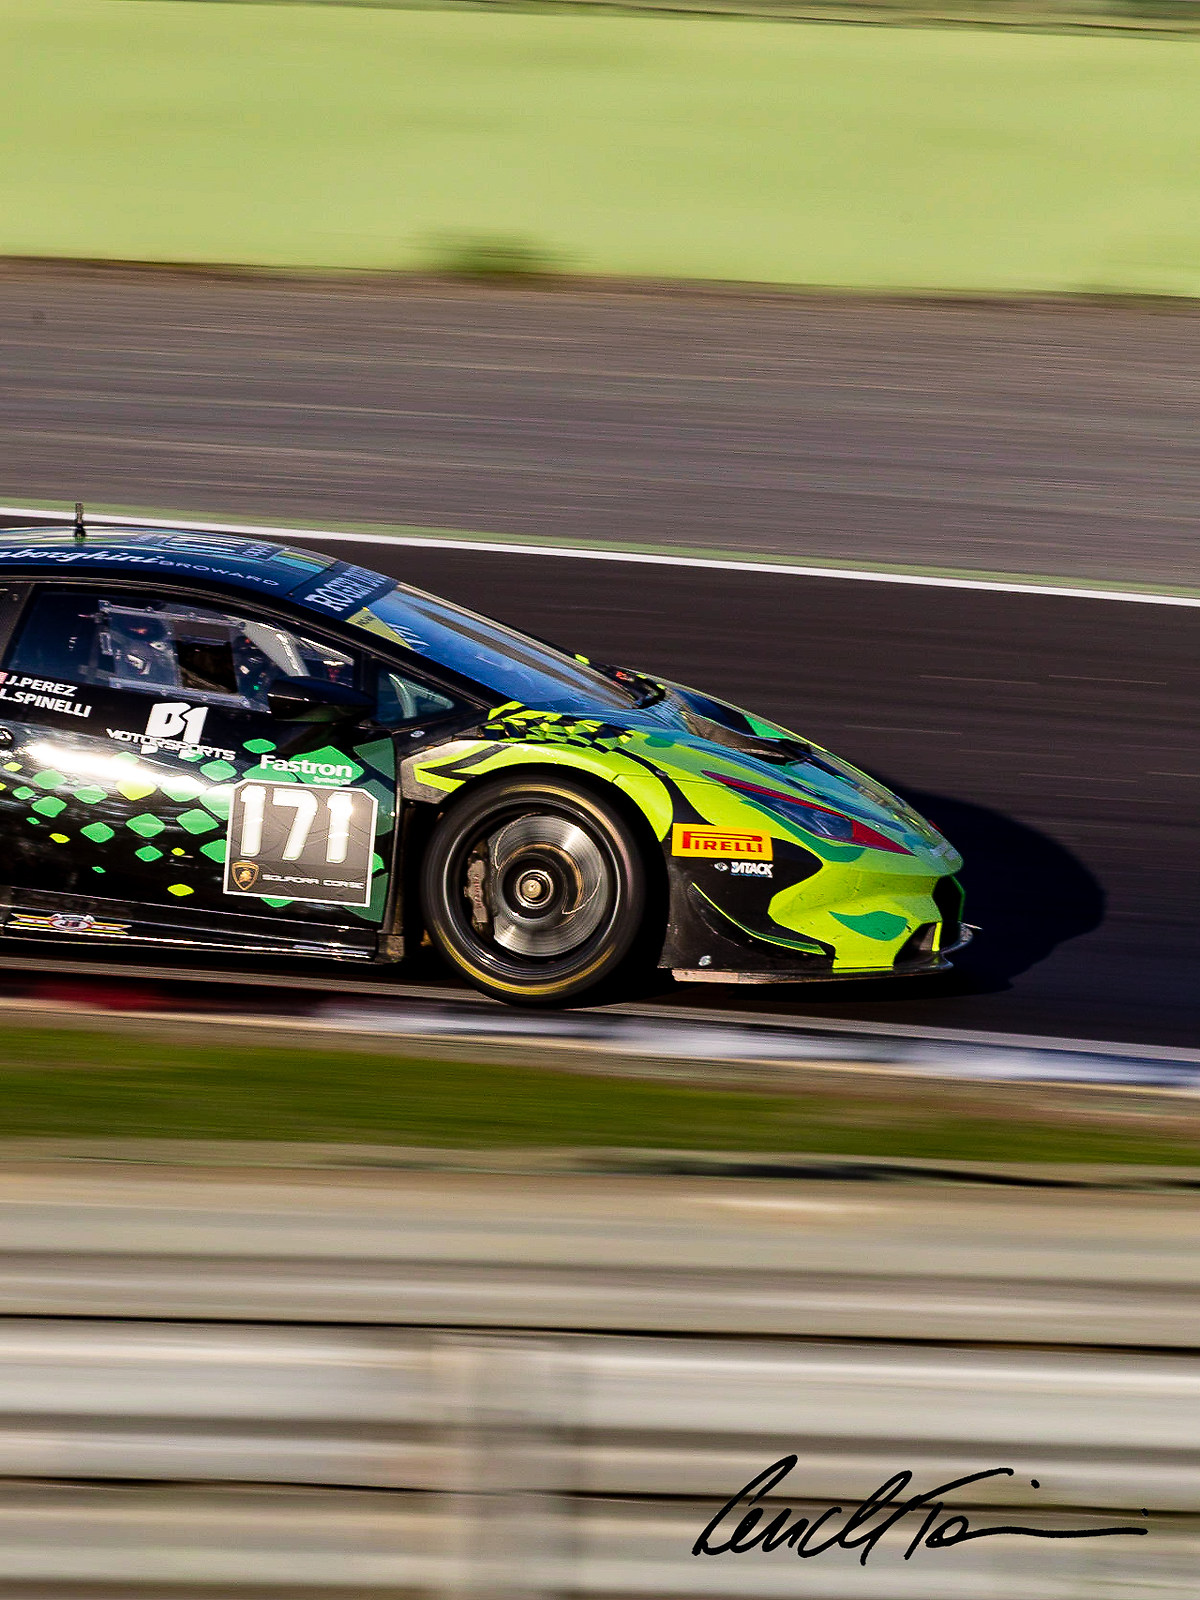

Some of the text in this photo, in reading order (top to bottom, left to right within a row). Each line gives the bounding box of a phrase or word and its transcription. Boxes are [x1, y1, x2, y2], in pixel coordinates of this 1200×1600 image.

[159, 560, 280, 586] BROWARD
[5, 675, 78, 697] J.PEREZ
[260, 754, 353, 778] Fastron
[240, 785, 354, 864] 171
[682, 831, 763, 853] PIRELLI
